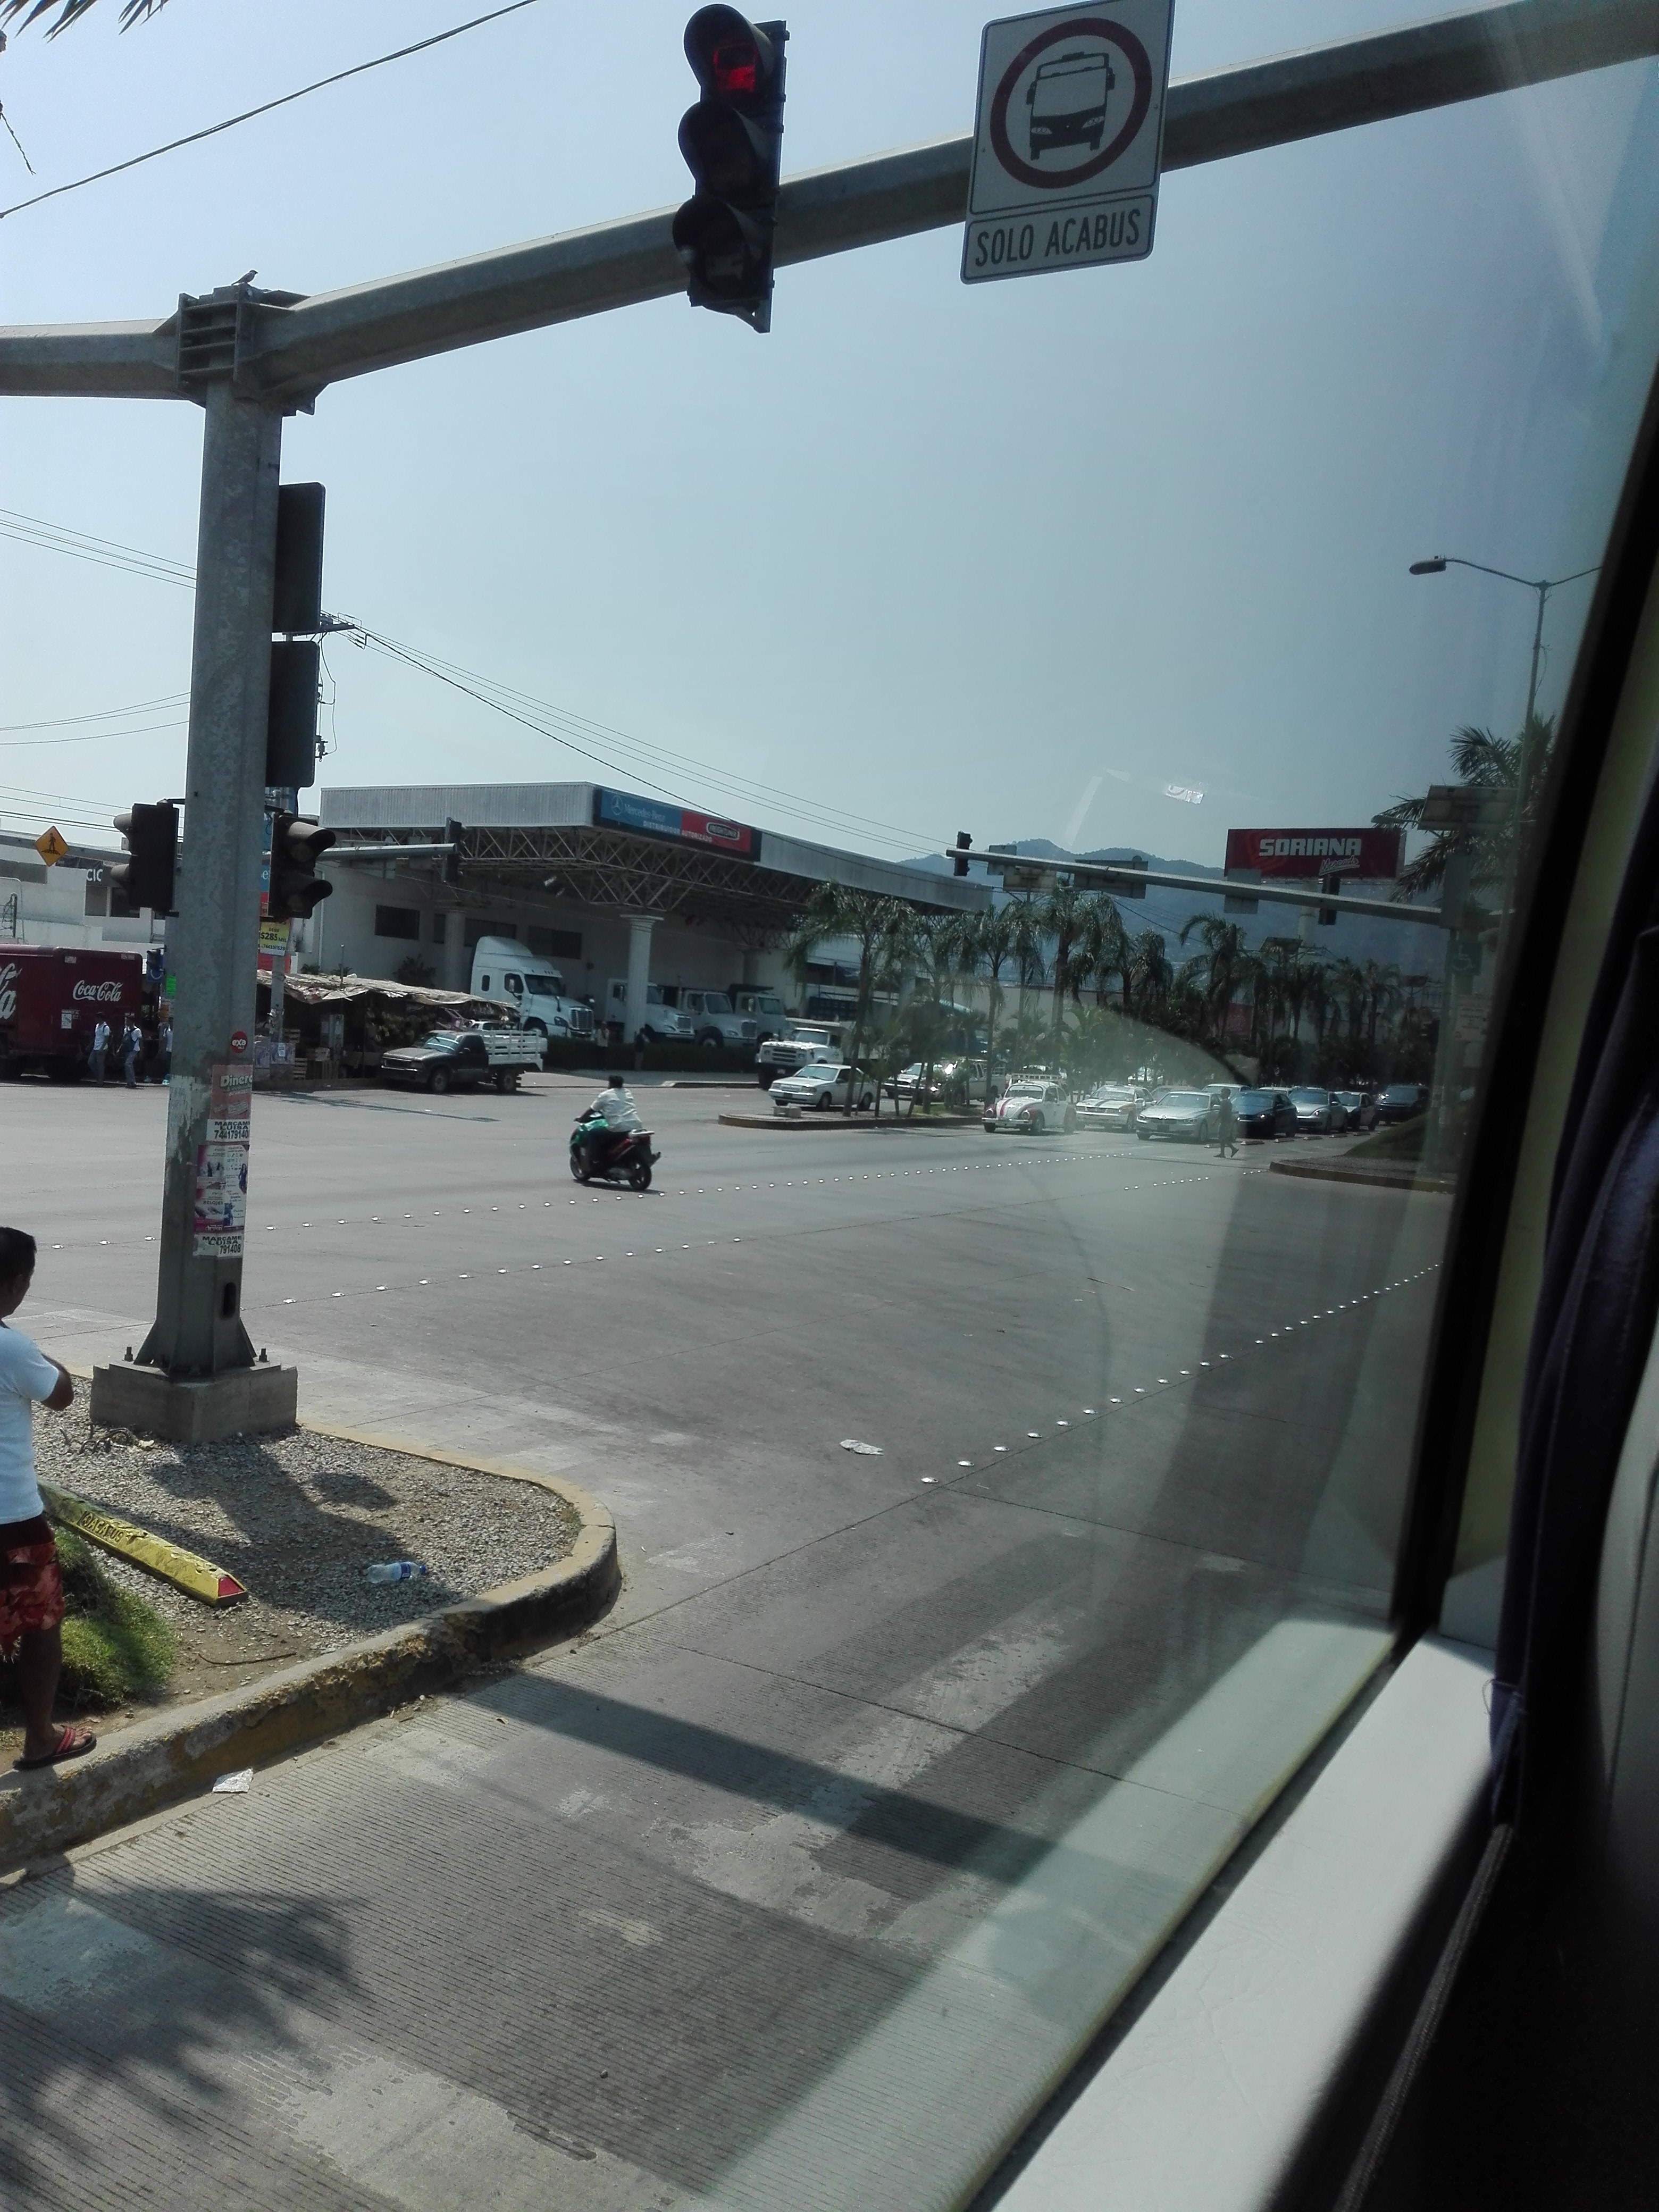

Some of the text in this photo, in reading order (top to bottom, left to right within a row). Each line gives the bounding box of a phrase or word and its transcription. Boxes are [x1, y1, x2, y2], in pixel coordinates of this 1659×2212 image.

[975, 208, 1141, 267] SOLO ACABUS
[1259, 838, 1362, 857] SORIANA
[72, 980, 123, 1002] Coca-Cola
[214, 1129, 250, 1139] 744179140
